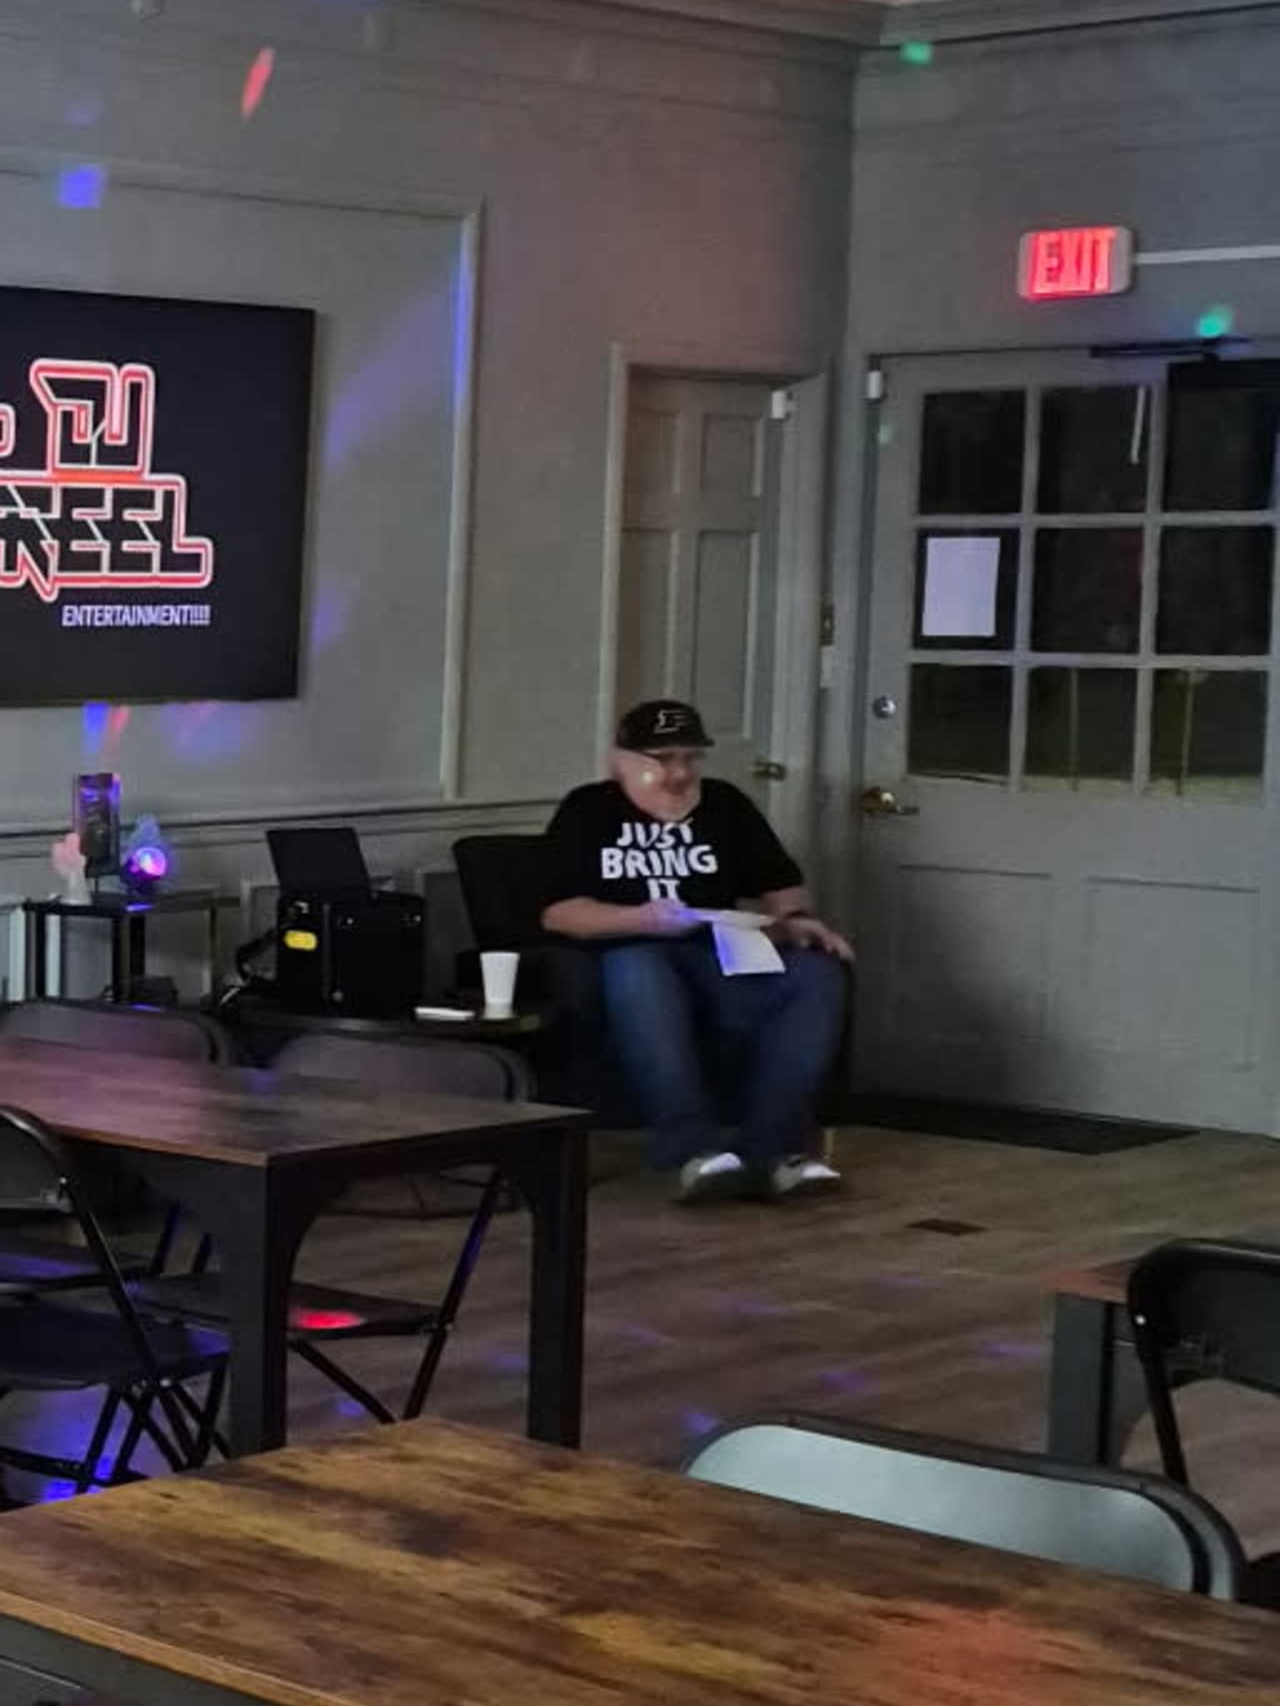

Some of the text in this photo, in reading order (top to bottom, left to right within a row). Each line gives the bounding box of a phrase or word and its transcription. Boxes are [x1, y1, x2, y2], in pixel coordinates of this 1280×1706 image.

[1034, 228, 1116, 293] EXIT
[616, 818, 694, 849] JUST
[600, 844, 719, 879] BRING
[646, 878, 681, 902] IT
